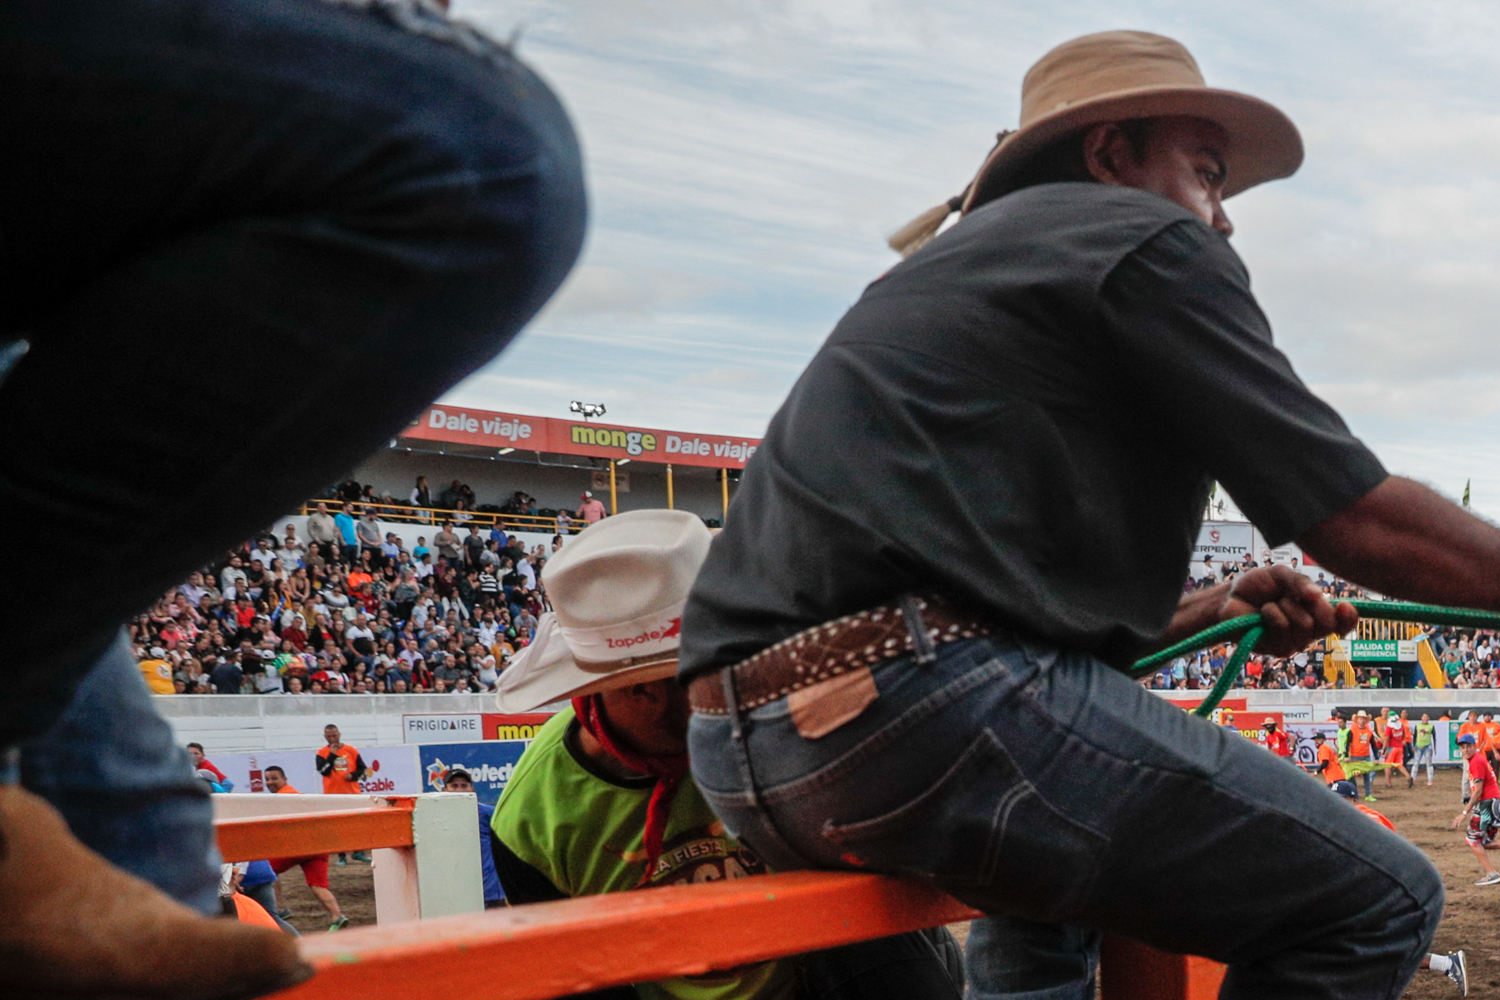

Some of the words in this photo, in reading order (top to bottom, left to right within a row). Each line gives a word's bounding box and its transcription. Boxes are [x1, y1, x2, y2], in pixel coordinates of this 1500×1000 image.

[429, 409, 479, 433] Dale
[482, 415, 532, 442] viaje
[571, 425, 657, 456] monge
[665, 435, 711, 456] Dale
[712, 440, 758, 463] viaje
[606, 630, 661, 648] zapote
[1353, 643, 1383, 651] SALIDA
[409, 719, 476, 731] FRIGIDAIRE
[674, 840, 724, 864] FIESTA
